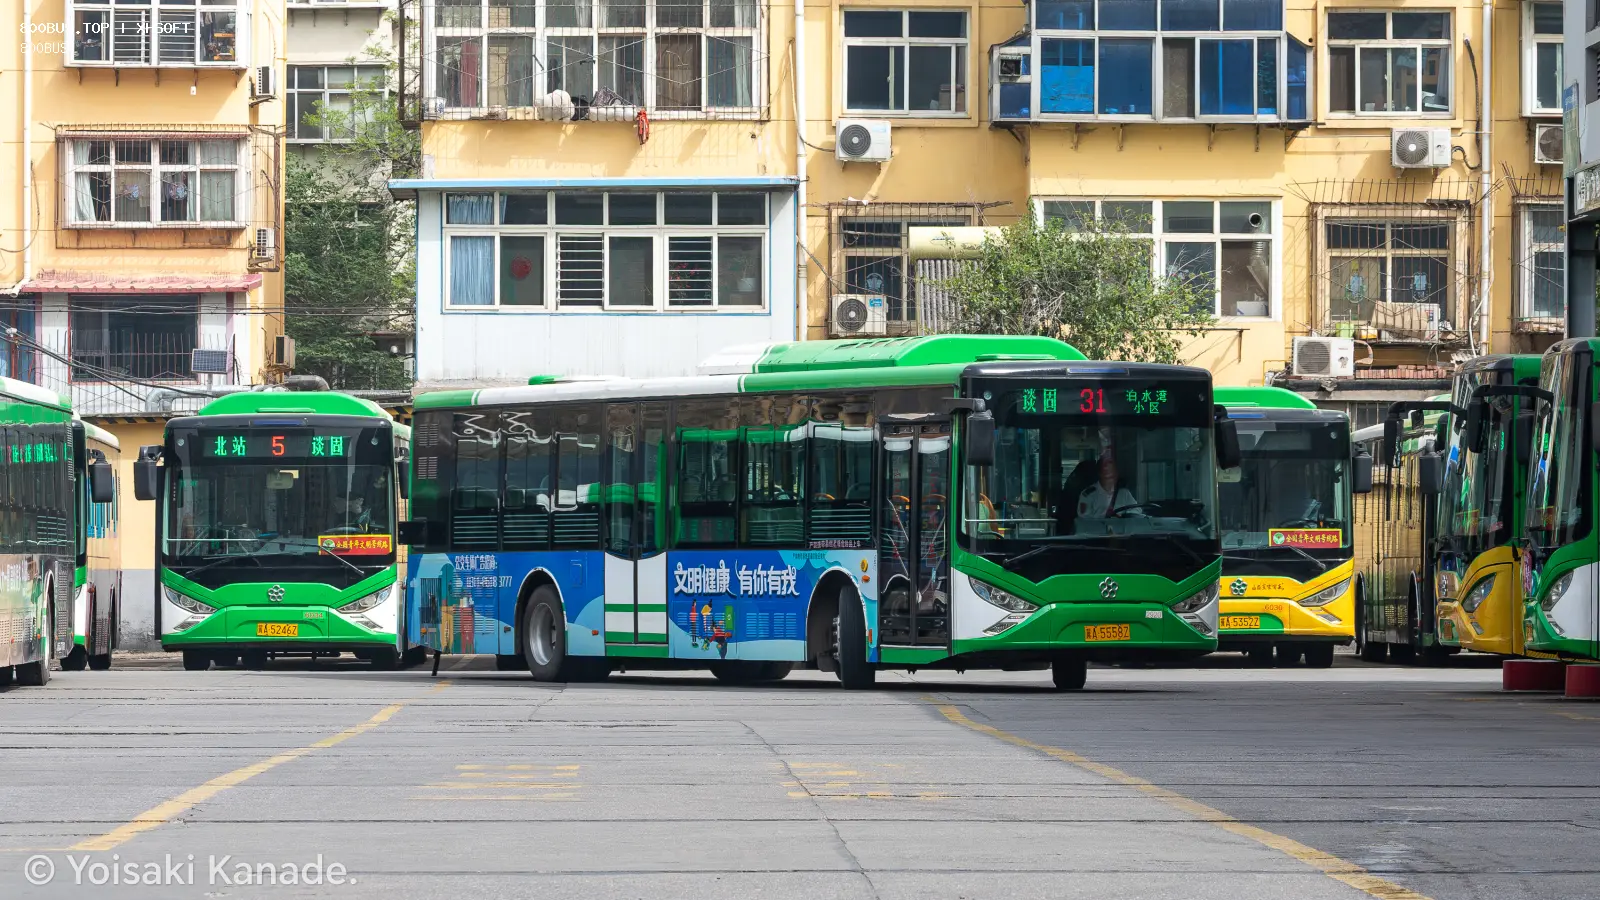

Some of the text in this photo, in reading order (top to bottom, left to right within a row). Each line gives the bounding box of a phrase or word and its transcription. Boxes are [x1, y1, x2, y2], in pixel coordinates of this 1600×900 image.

[1022, 388, 1167, 413] 谈固 31 泊水湾
[1134, 402, 1160, 414] 小区
[214, 435, 343, 456] 北站 5 谈固
[674, 559, 800, 598] 文明健康 有你有我
